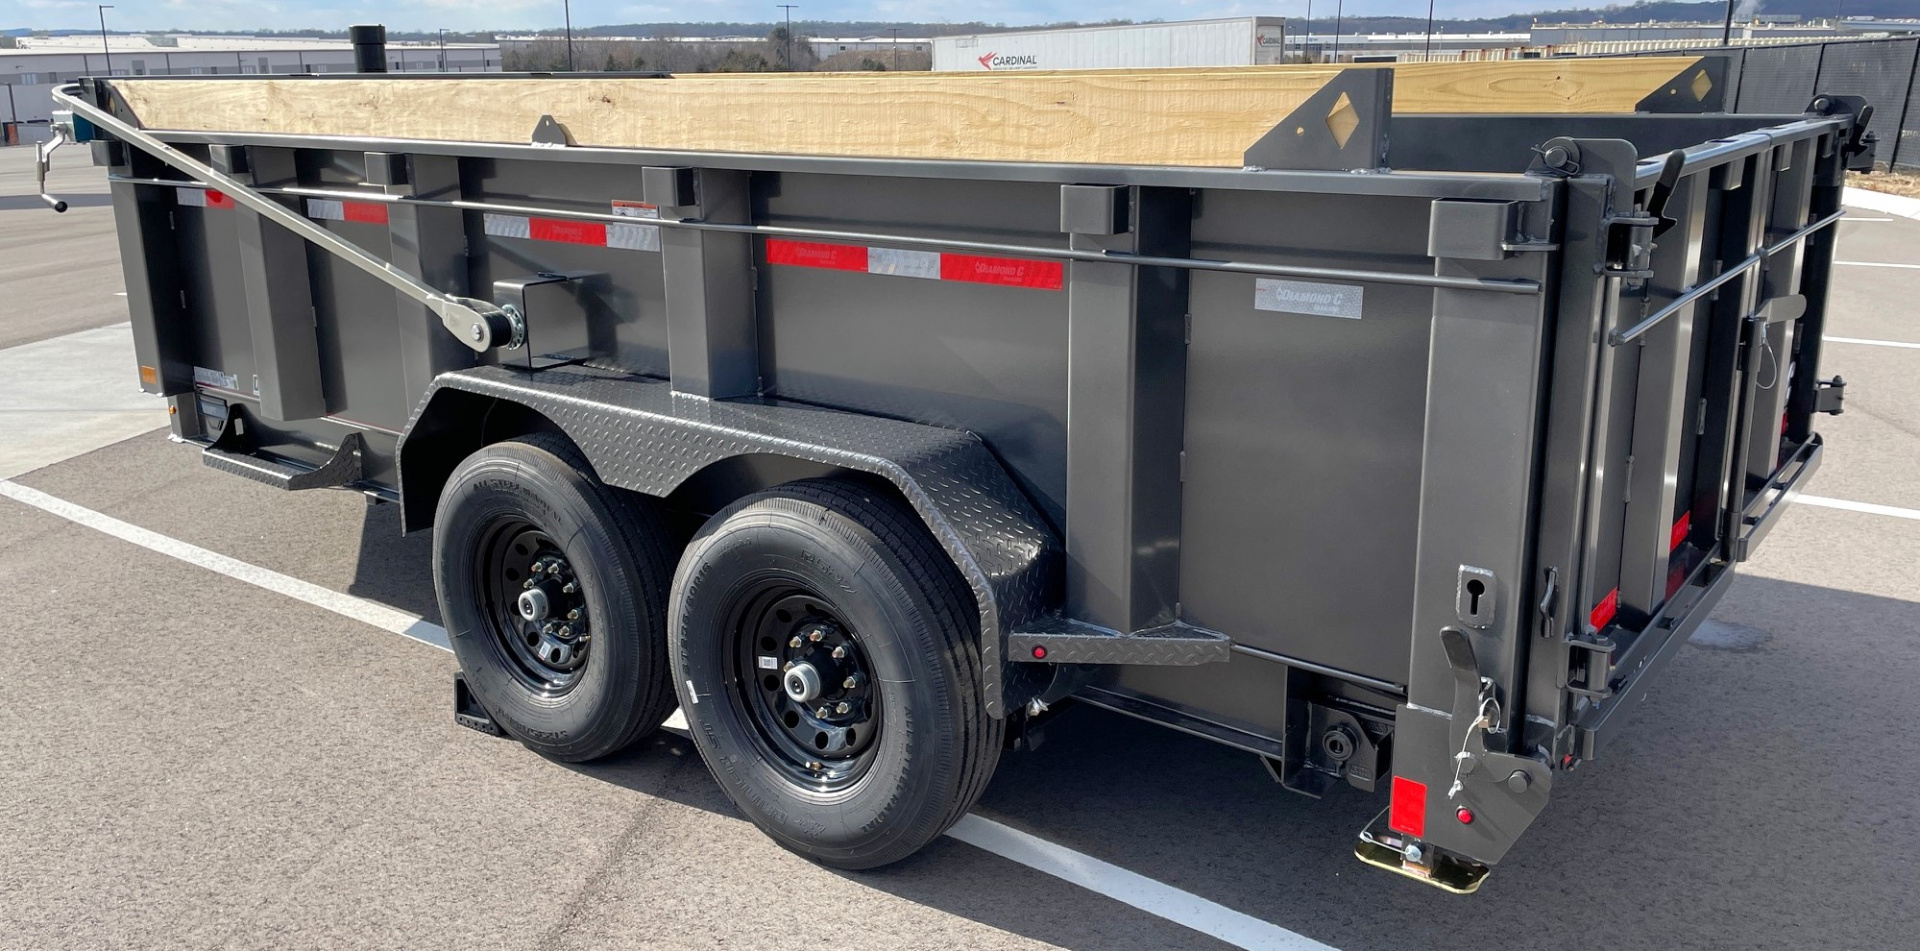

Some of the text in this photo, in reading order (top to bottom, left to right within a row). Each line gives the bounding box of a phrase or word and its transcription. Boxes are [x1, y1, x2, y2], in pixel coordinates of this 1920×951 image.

[992, 55, 1038, 66] CARDINAL
[979, 264, 1025, 277] DIAMOND C
[1283, 289, 1344, 306] DIAMOND C
